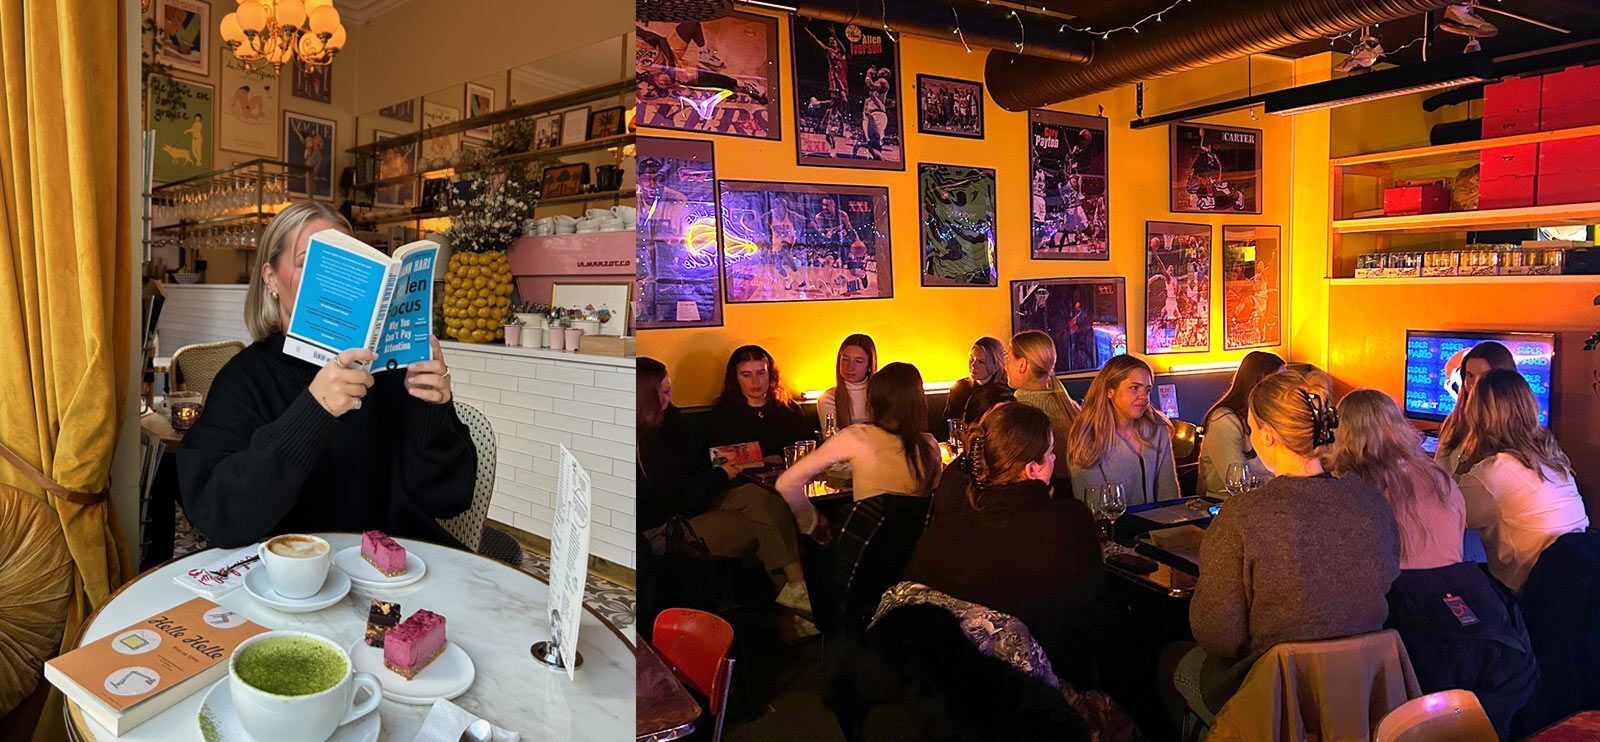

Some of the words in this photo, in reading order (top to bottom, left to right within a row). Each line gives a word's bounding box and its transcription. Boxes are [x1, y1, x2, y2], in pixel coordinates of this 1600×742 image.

[862, 34, 881, 45] Allen
[850, 43, 882, 55] Iverson
[290, 118, 332, 138] VOGUE
[1044, 128, 1059, 138] Gary
[1035, 135, 1059, 149] Payton
[1224, 132, 1255, 144] CARTER
[849, 200, 871, 213] XXL
[413, 257, 431, 272] HARI
[389, 322, 399, 331] Why
[400, 319, 411, 328] You
[400, 330, 412, 340] Pay
[383, 342, 411, 354] Attention
[1516, 346, 1542, 355] SUPER
[148, 616, 187, 639] Helle
[183, 635, 225, 660] Helle
